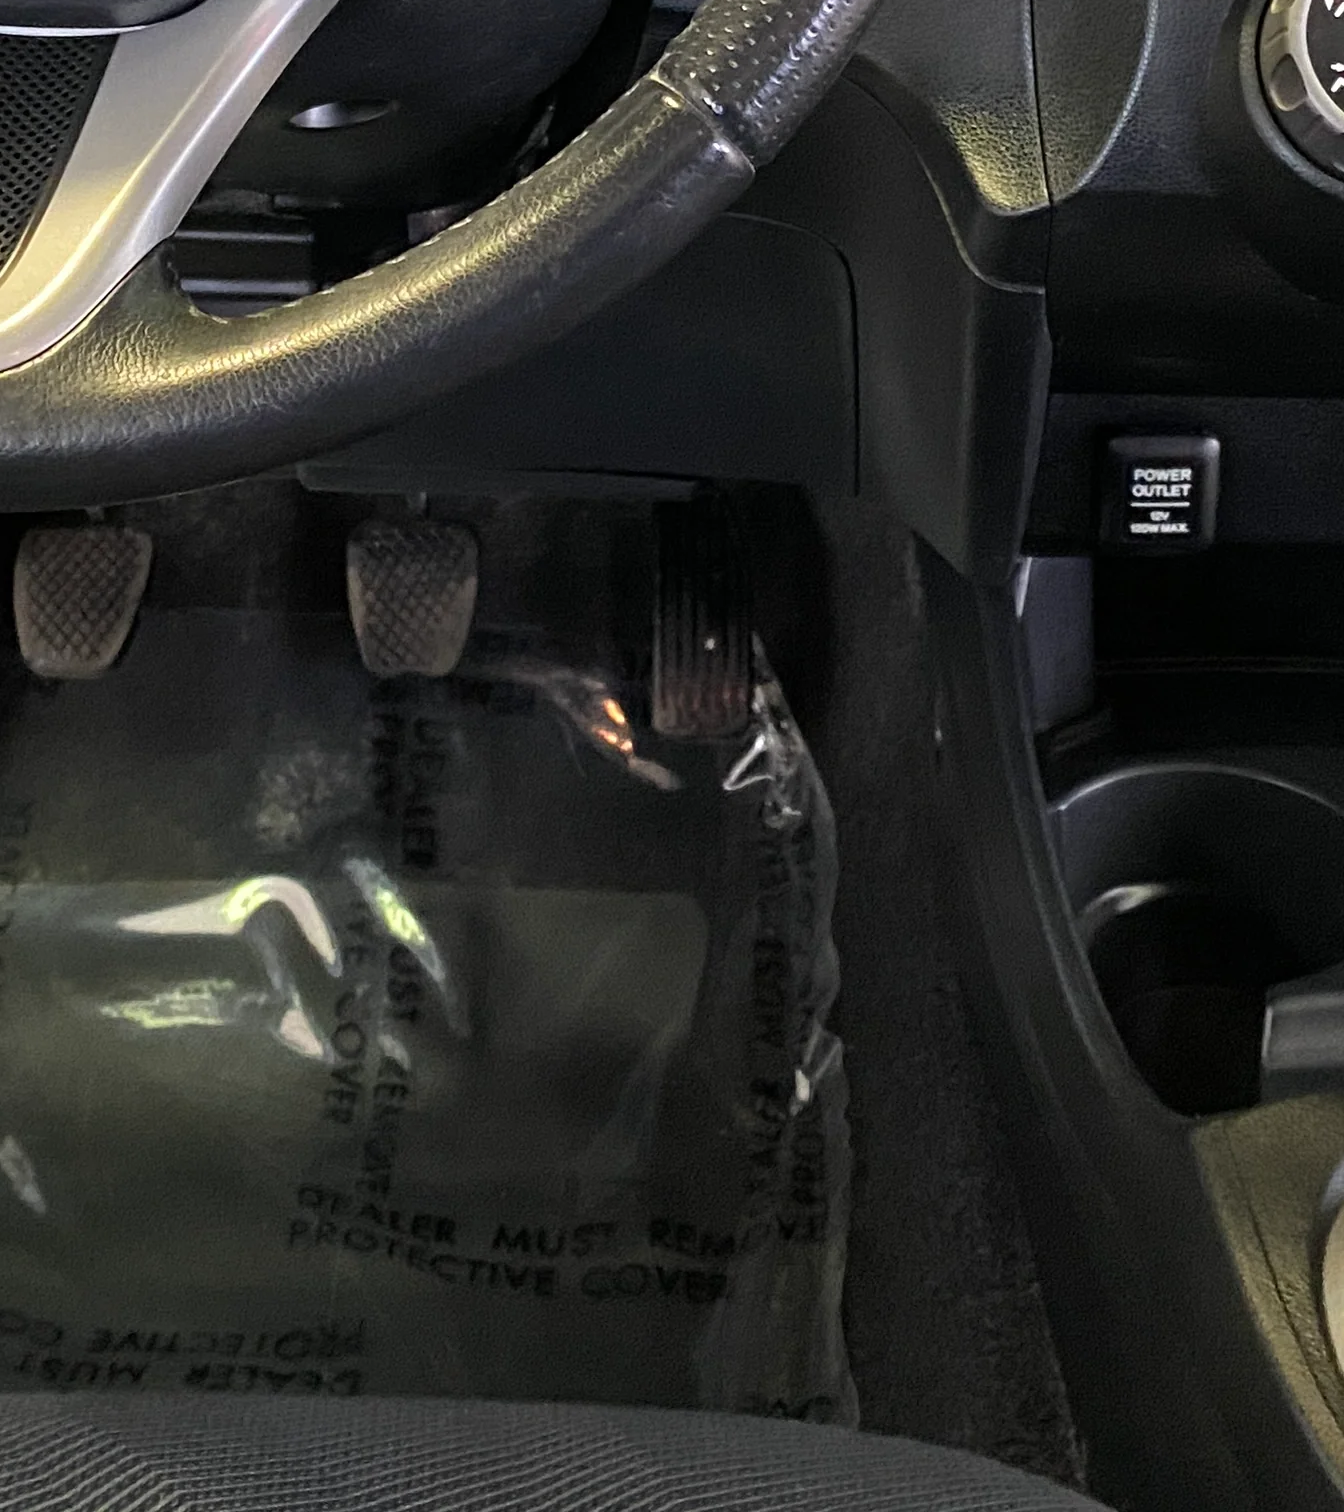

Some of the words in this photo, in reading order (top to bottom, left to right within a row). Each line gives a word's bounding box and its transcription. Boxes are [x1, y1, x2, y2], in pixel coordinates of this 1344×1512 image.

[1133, 468, 1192, 481] POWER
[1131, 483, 1193, 497] OUTLET
[492, 1220, 619, 1258] MUST
[287, 1217, 560, 1300] PROTECTIVE
